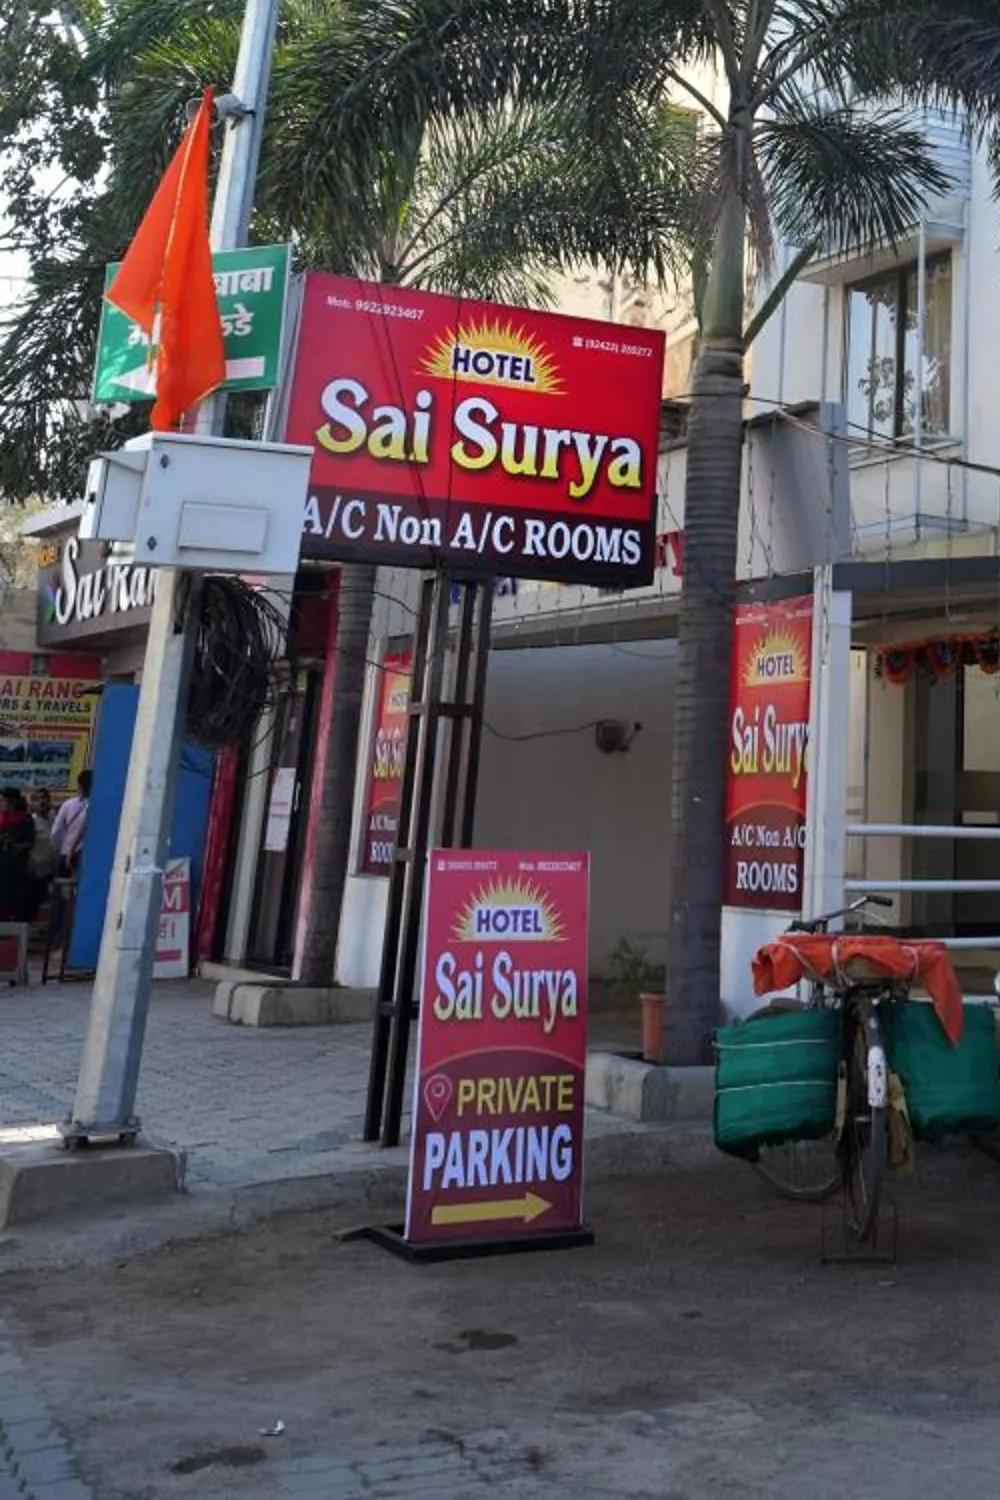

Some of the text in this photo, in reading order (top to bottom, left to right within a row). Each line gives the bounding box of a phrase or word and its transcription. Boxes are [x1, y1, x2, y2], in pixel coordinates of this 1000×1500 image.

[453, 346, 536, 383] HOTEL
[316, 379, 643, 500] Sai Surya
[302, 495, 366, 539] A/C
[376, 502, 442, 547] Non
[449, 510, 515, 555] A/C
[523, 518, 642, 566] ROOMS
[756, 653, 796, 676] HOTEL
[731, 707, 760, 774] Sai
[731, 825, 754, 847] A/C
[756, 824, 779, 847] Non
[736, 862, 798, 893] ROOMS
[477, 908, 543, 934] HOTEL
[434, 950, 577, 1034] Sai Surya
[456, 1074, 575, 1117] PRIVATE
[423, 1123, 573, 1191] PARKING
